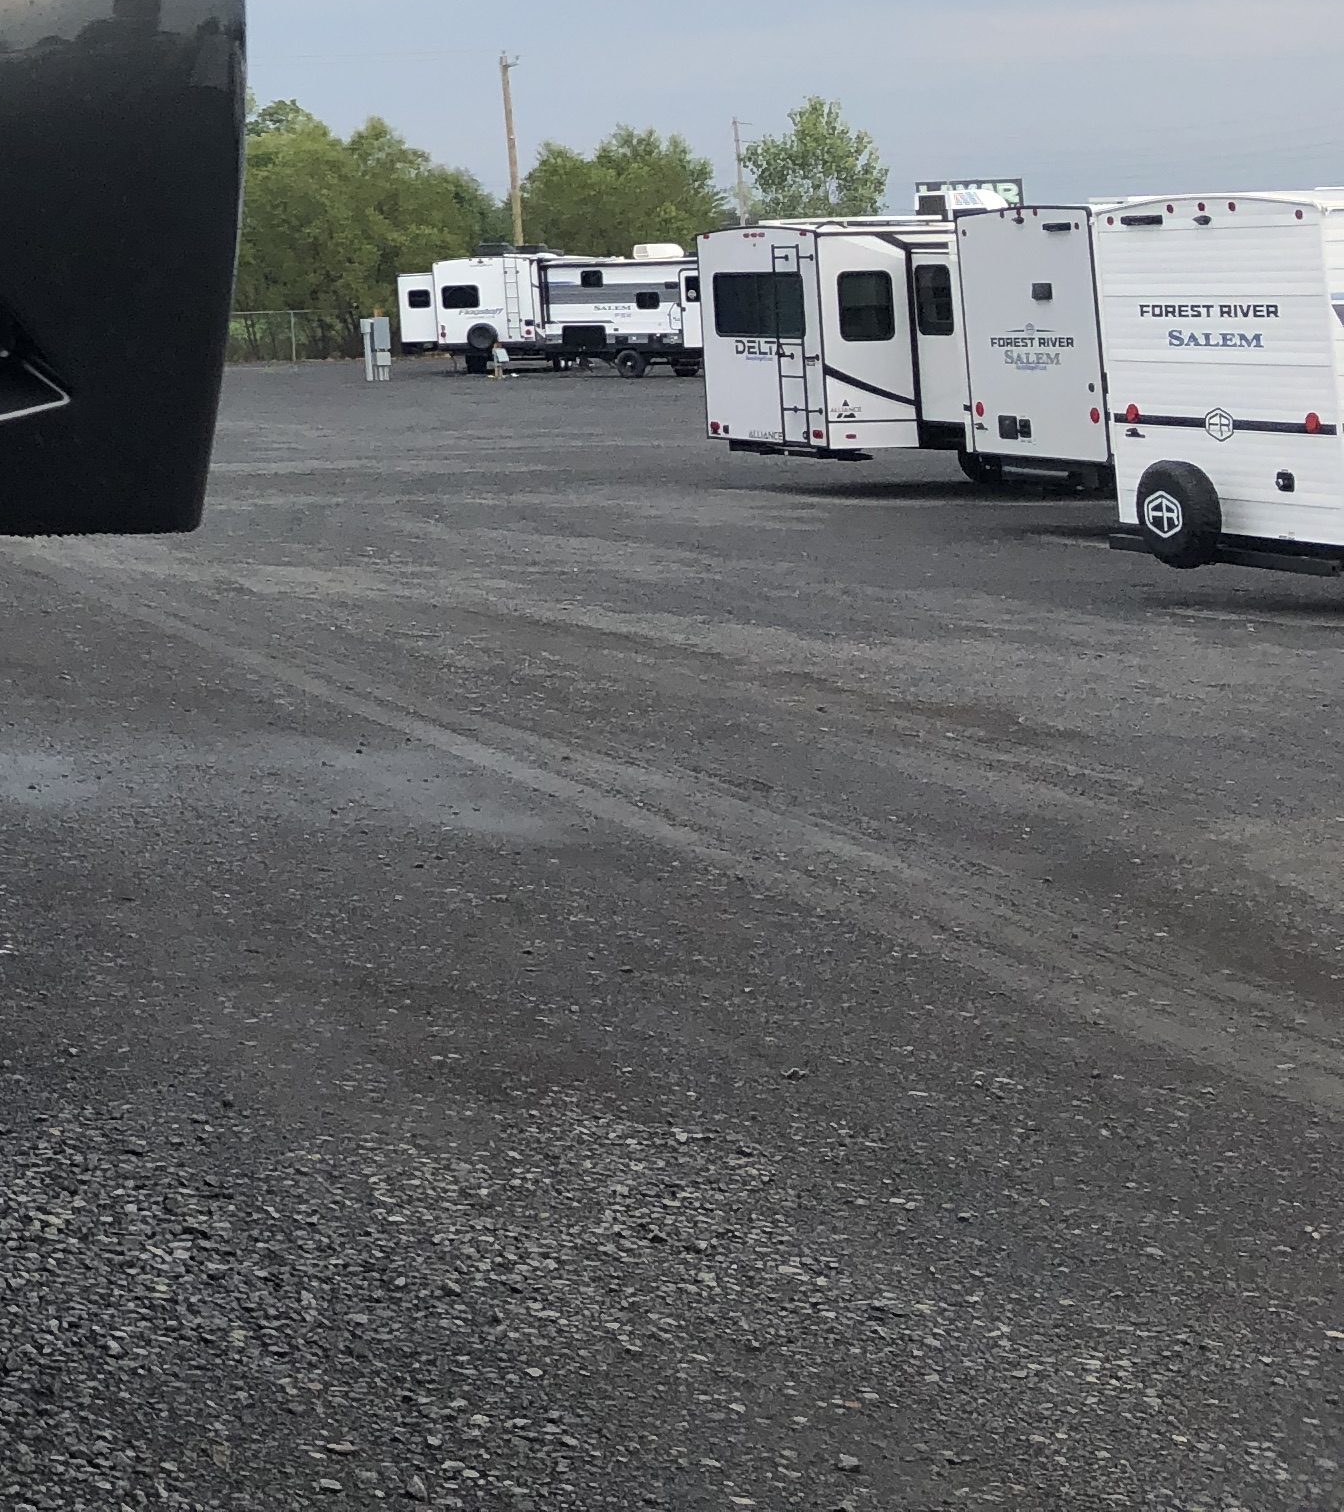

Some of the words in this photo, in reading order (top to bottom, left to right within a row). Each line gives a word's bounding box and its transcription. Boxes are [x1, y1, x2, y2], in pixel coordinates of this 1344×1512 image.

[1139, 304, 1215, 318] FOREST
[1219, 304, 1280, 318] RIVER
[990, 336, 1036, 348] FOREST
[1038, 336, 1075, 348] RIVER
[1167, 329, 1265, 349] SALEM
[1003, 349, 1062, 366] SALEM
